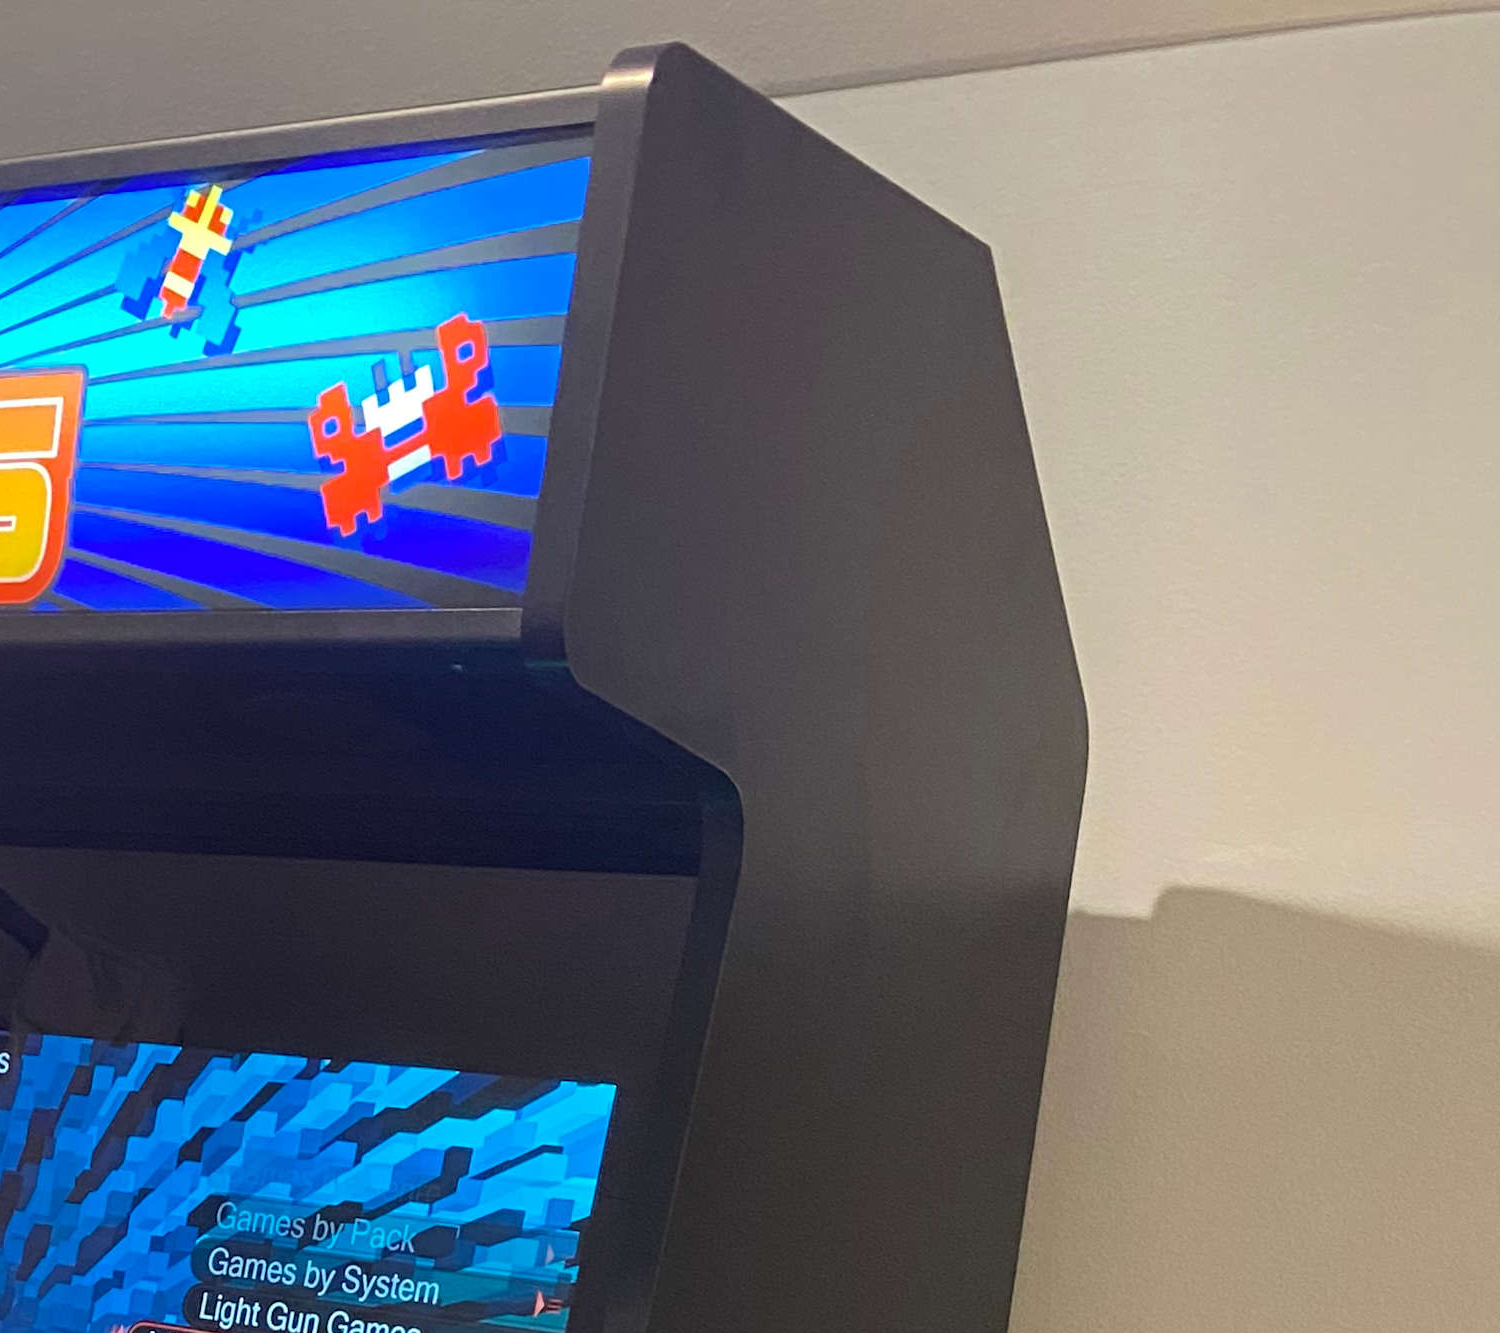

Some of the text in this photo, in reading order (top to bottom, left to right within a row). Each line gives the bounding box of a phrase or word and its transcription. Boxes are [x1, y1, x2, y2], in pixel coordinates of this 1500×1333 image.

[216, 1201, 415, 1253] Games by Pack
[208, 1246, 440, 1305] Games by System
[199, 1291, 260, 1331] Light
